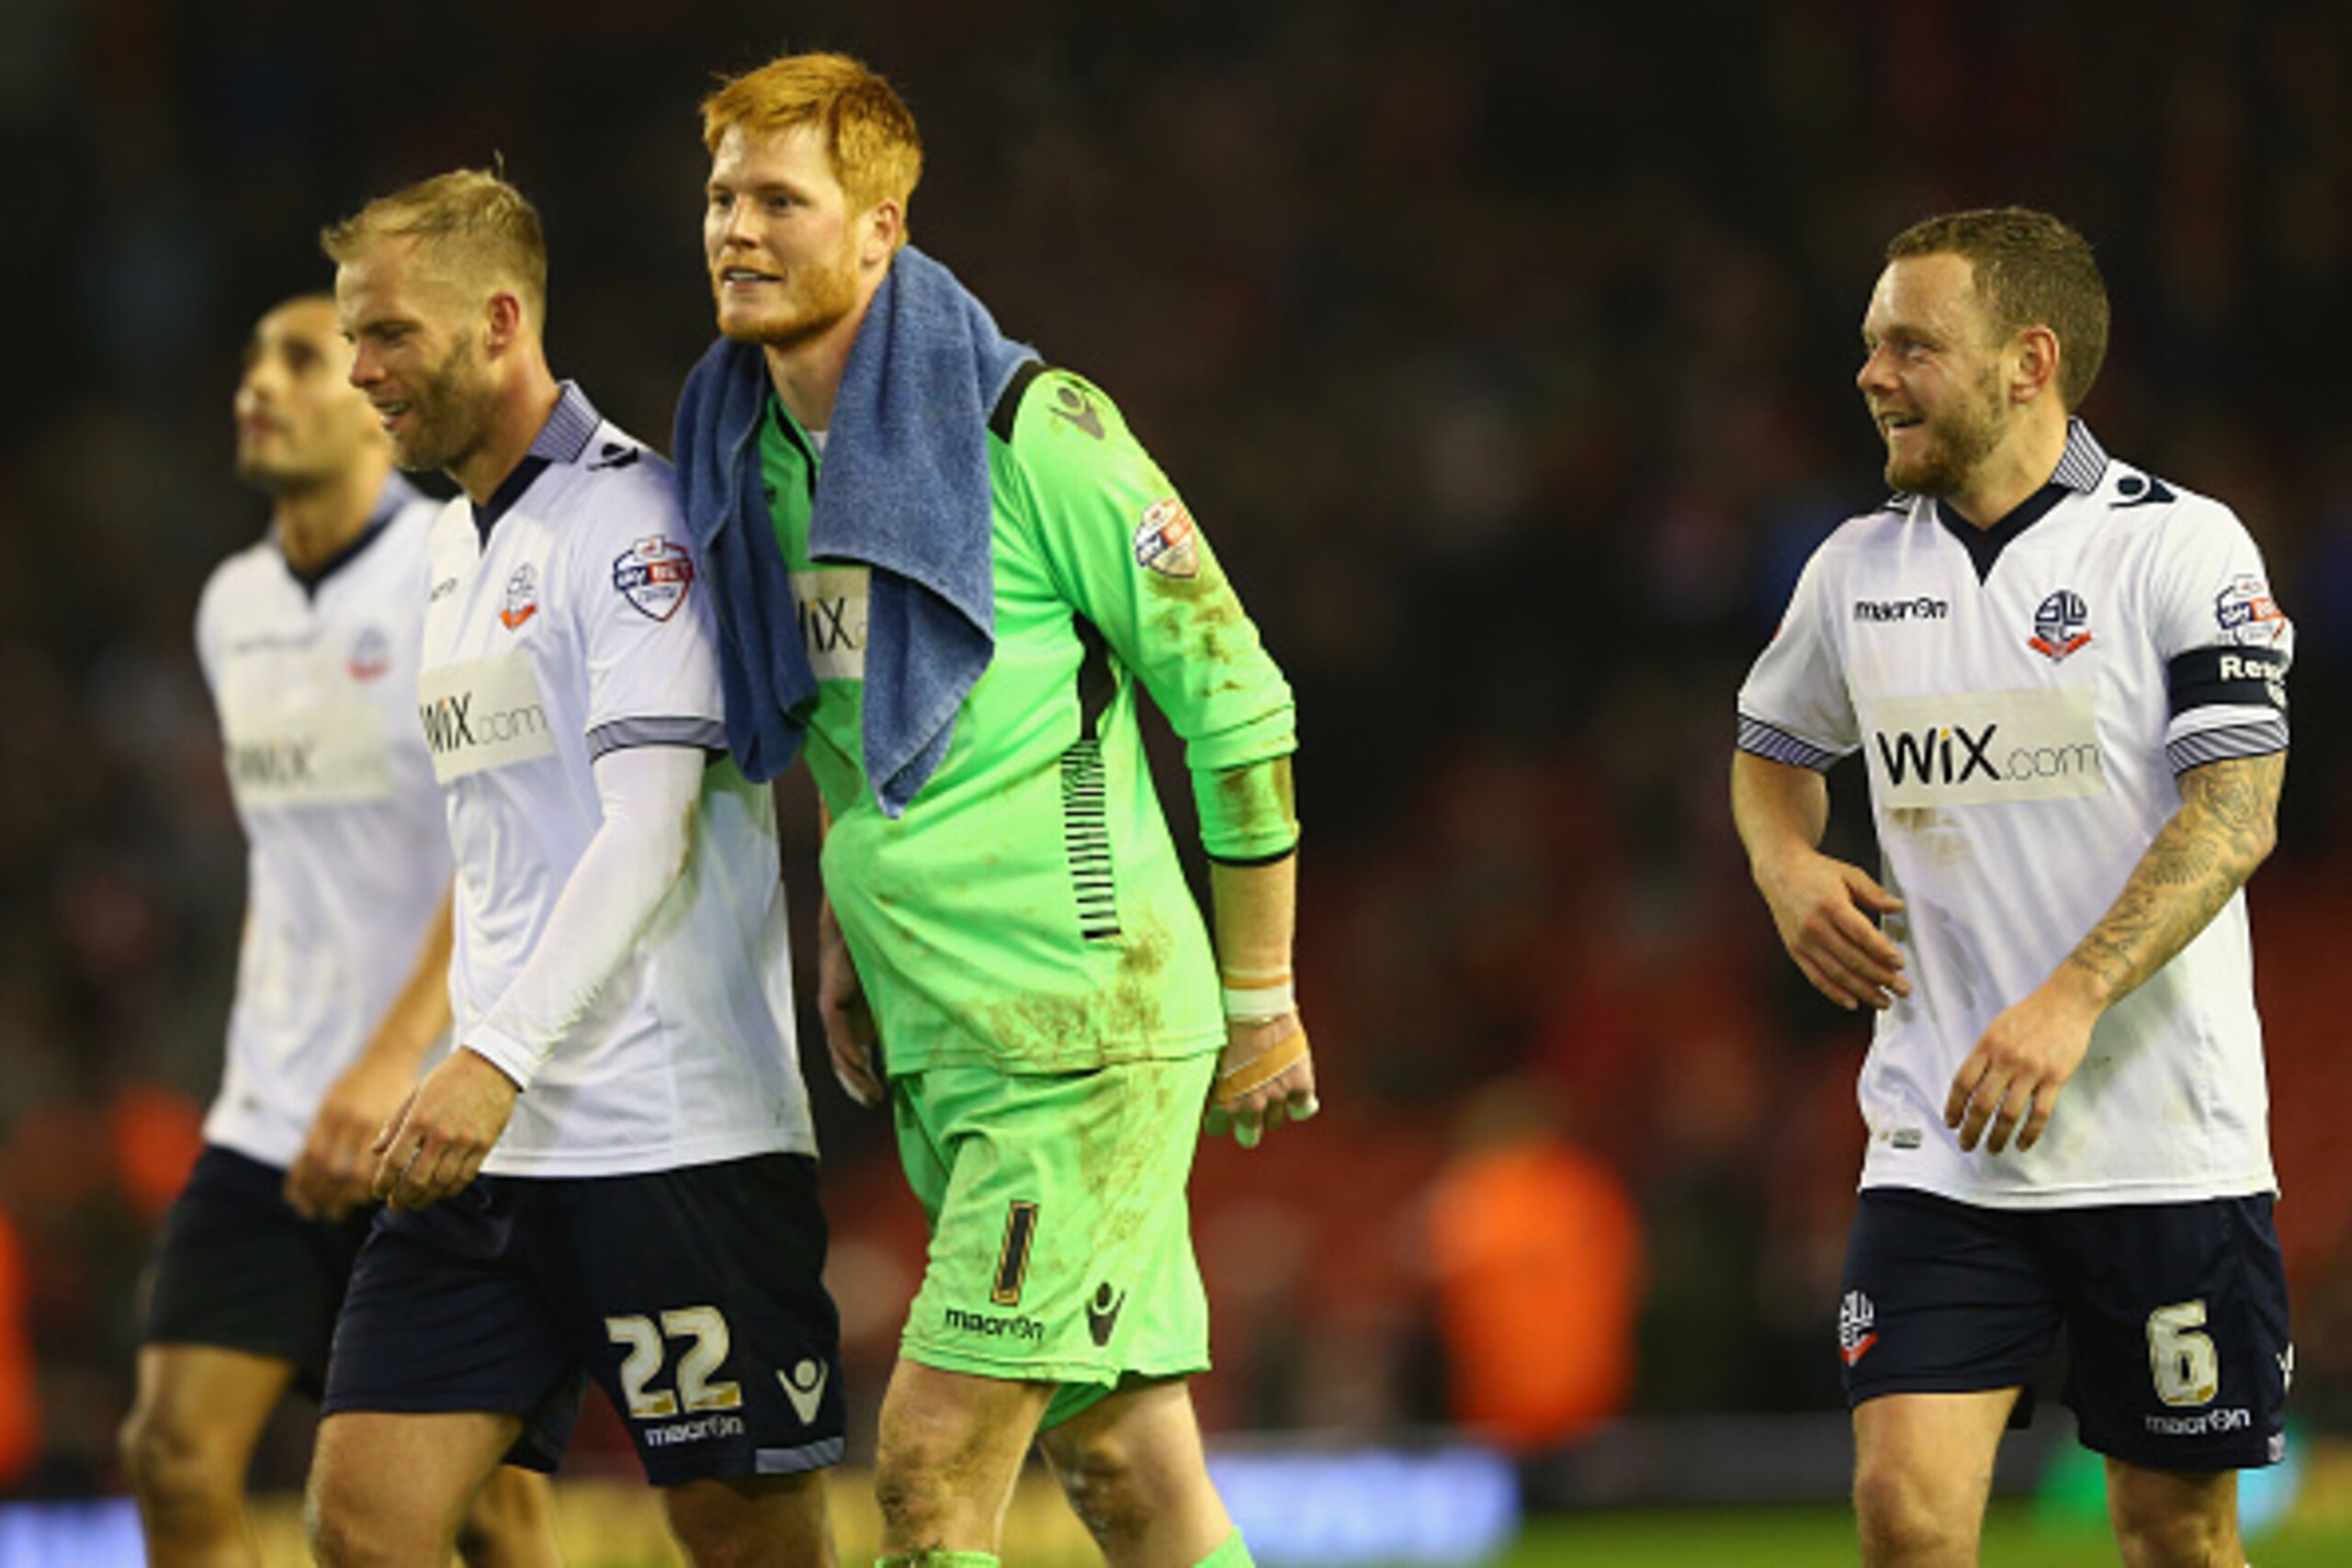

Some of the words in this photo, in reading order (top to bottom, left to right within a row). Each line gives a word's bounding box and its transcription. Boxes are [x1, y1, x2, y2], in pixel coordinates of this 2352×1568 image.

[1854, 596, 1949, 622] macron
[990, 1199, 1040, 1307] 1
[945, 1307, 1046, 1342] macron
[605, 1305, 742, 1417] 22
[2146, 1299, 2219, 1406] 6
[645, 1414, 745, 1447] macron
[2145, 1408, 2251, 1435] macron
